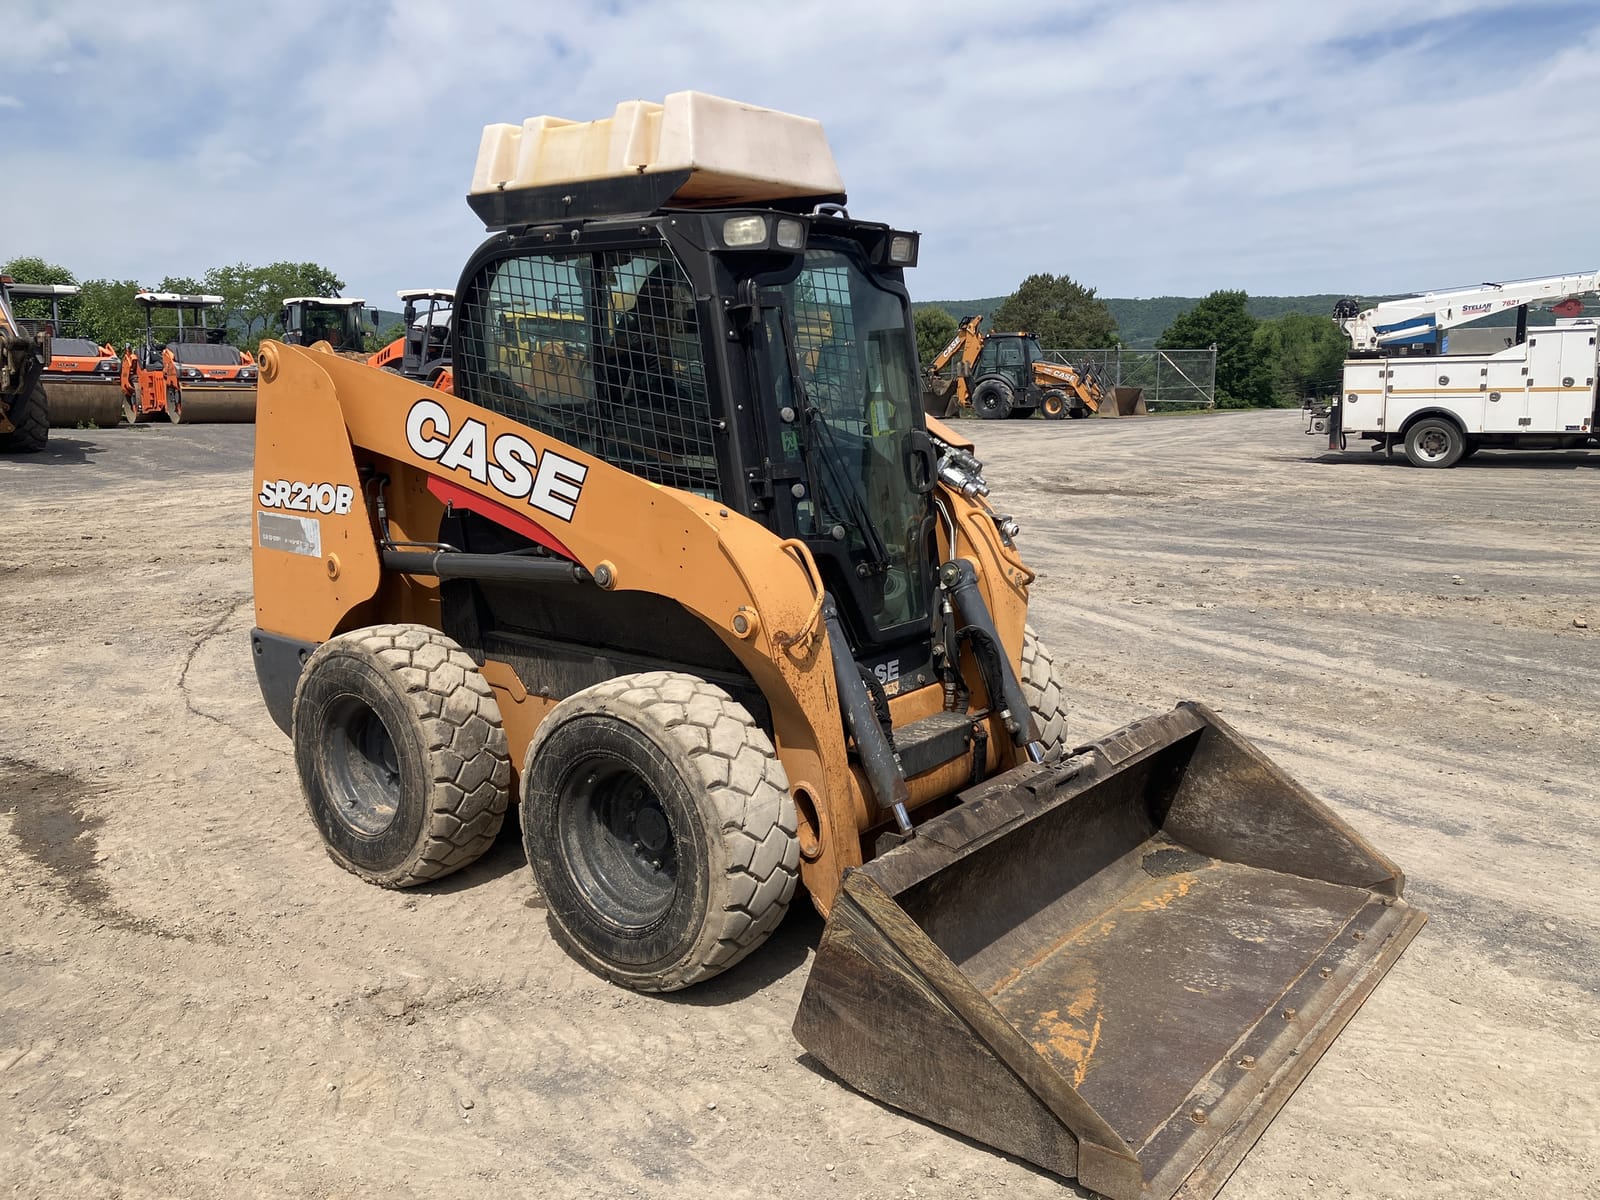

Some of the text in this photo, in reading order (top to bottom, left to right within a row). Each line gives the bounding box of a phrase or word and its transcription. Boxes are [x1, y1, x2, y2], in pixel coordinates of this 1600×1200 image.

[1462, 303, 1492, 312] STELLAR
[1053, 370, 1076, 382] CASE
[406, 398, 589, 523] CASE
[258, 479, 354, 515] SR210B
[874, 659, 899, 685] SE
